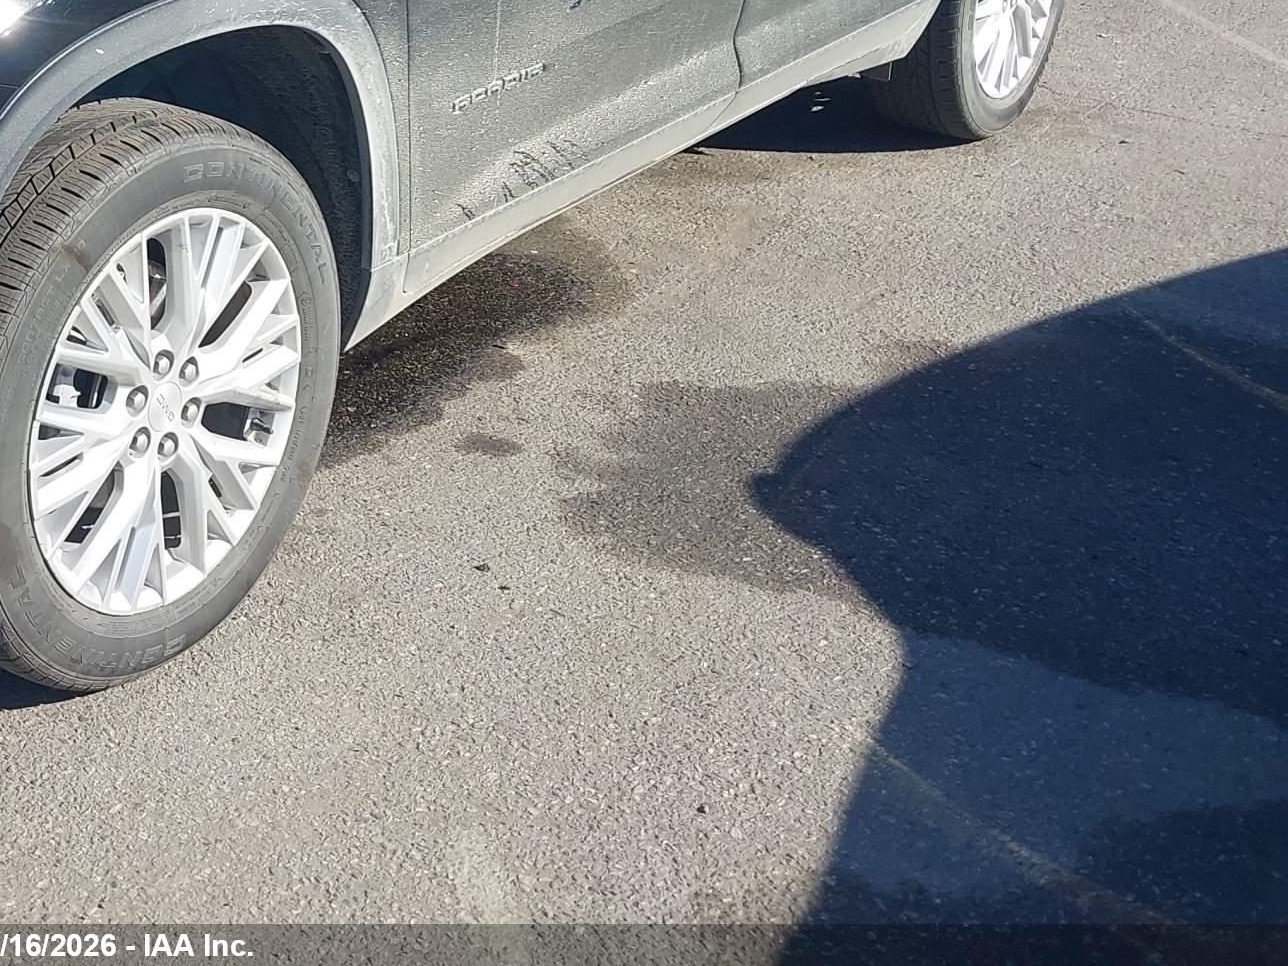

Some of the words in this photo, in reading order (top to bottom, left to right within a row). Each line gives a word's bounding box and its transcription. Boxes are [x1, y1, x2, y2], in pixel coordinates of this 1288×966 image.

[183, 160, 326, 285] CONTINENTAL
[156, 393, 175, 422] GMC
[9, 564, 187, 668] CONTINENTAL
